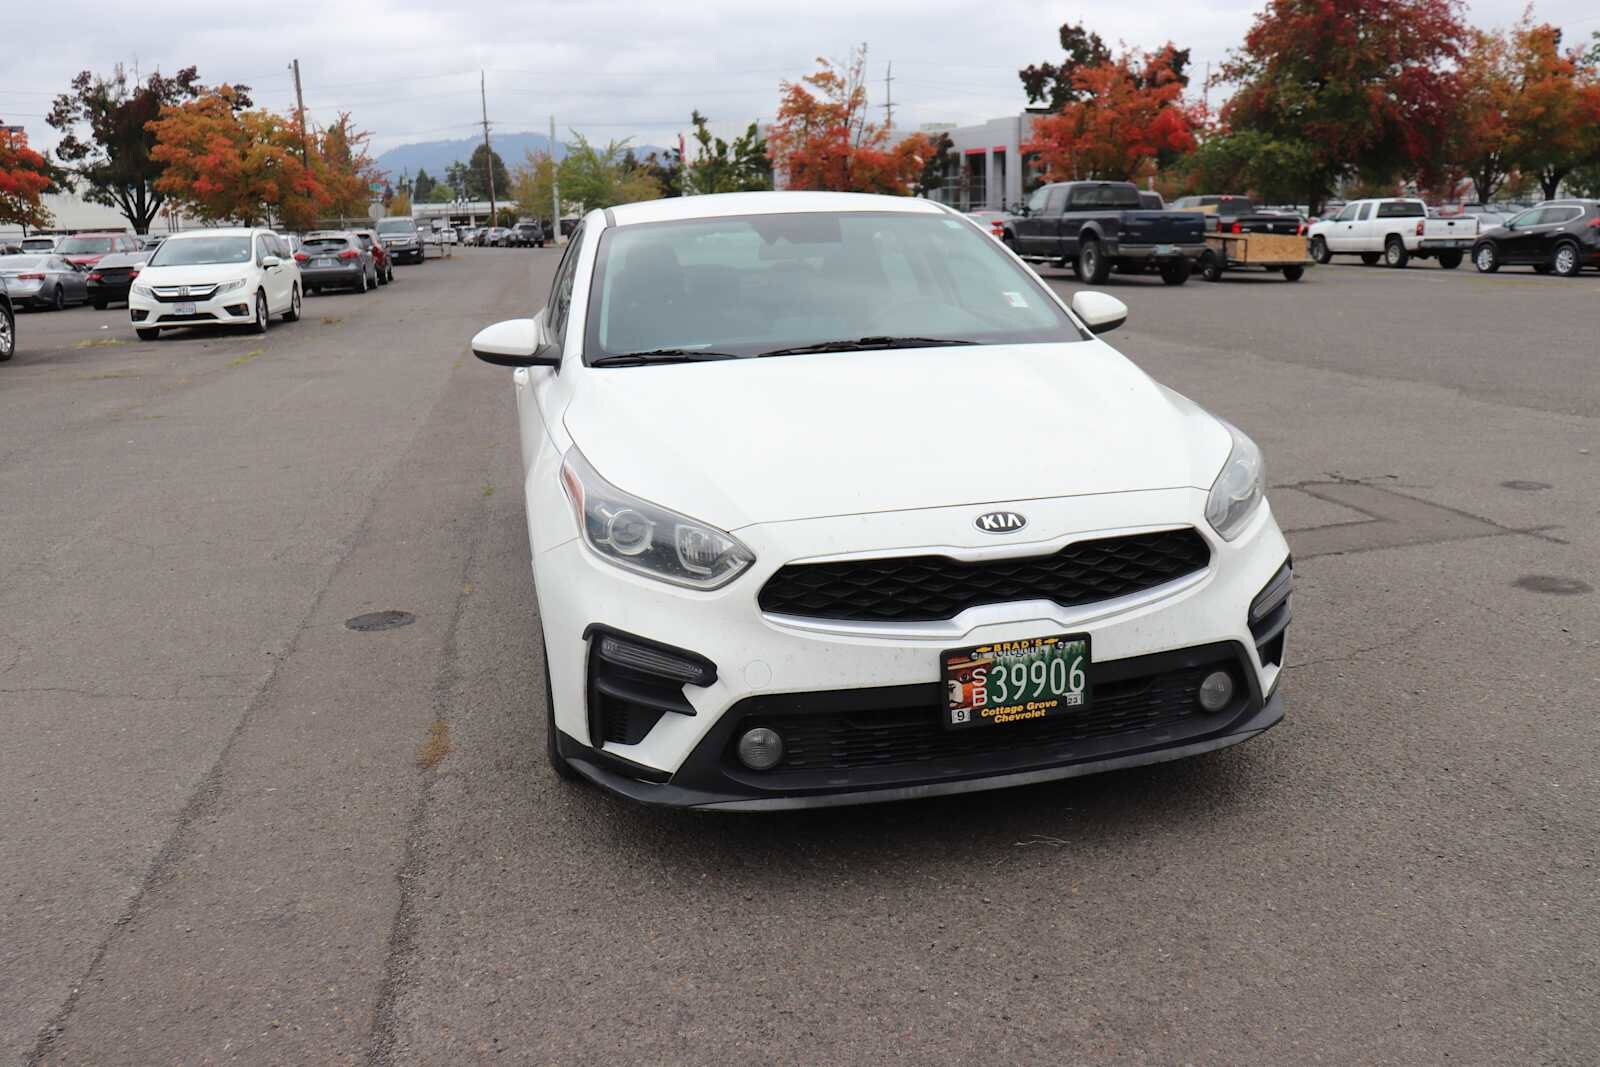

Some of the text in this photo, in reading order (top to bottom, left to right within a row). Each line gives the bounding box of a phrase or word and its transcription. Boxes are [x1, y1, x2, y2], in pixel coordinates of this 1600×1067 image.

[981, 513, 1022, 530] KIA
[994, 638, 1043, 652] BRAD'S
[991, 656, 1085, 703] 39906
[957, 710, 965, 721] 9
[981, 699, 1057, 718] Cottage Grove
[994, 709, 1046, 723] Chevrolet
